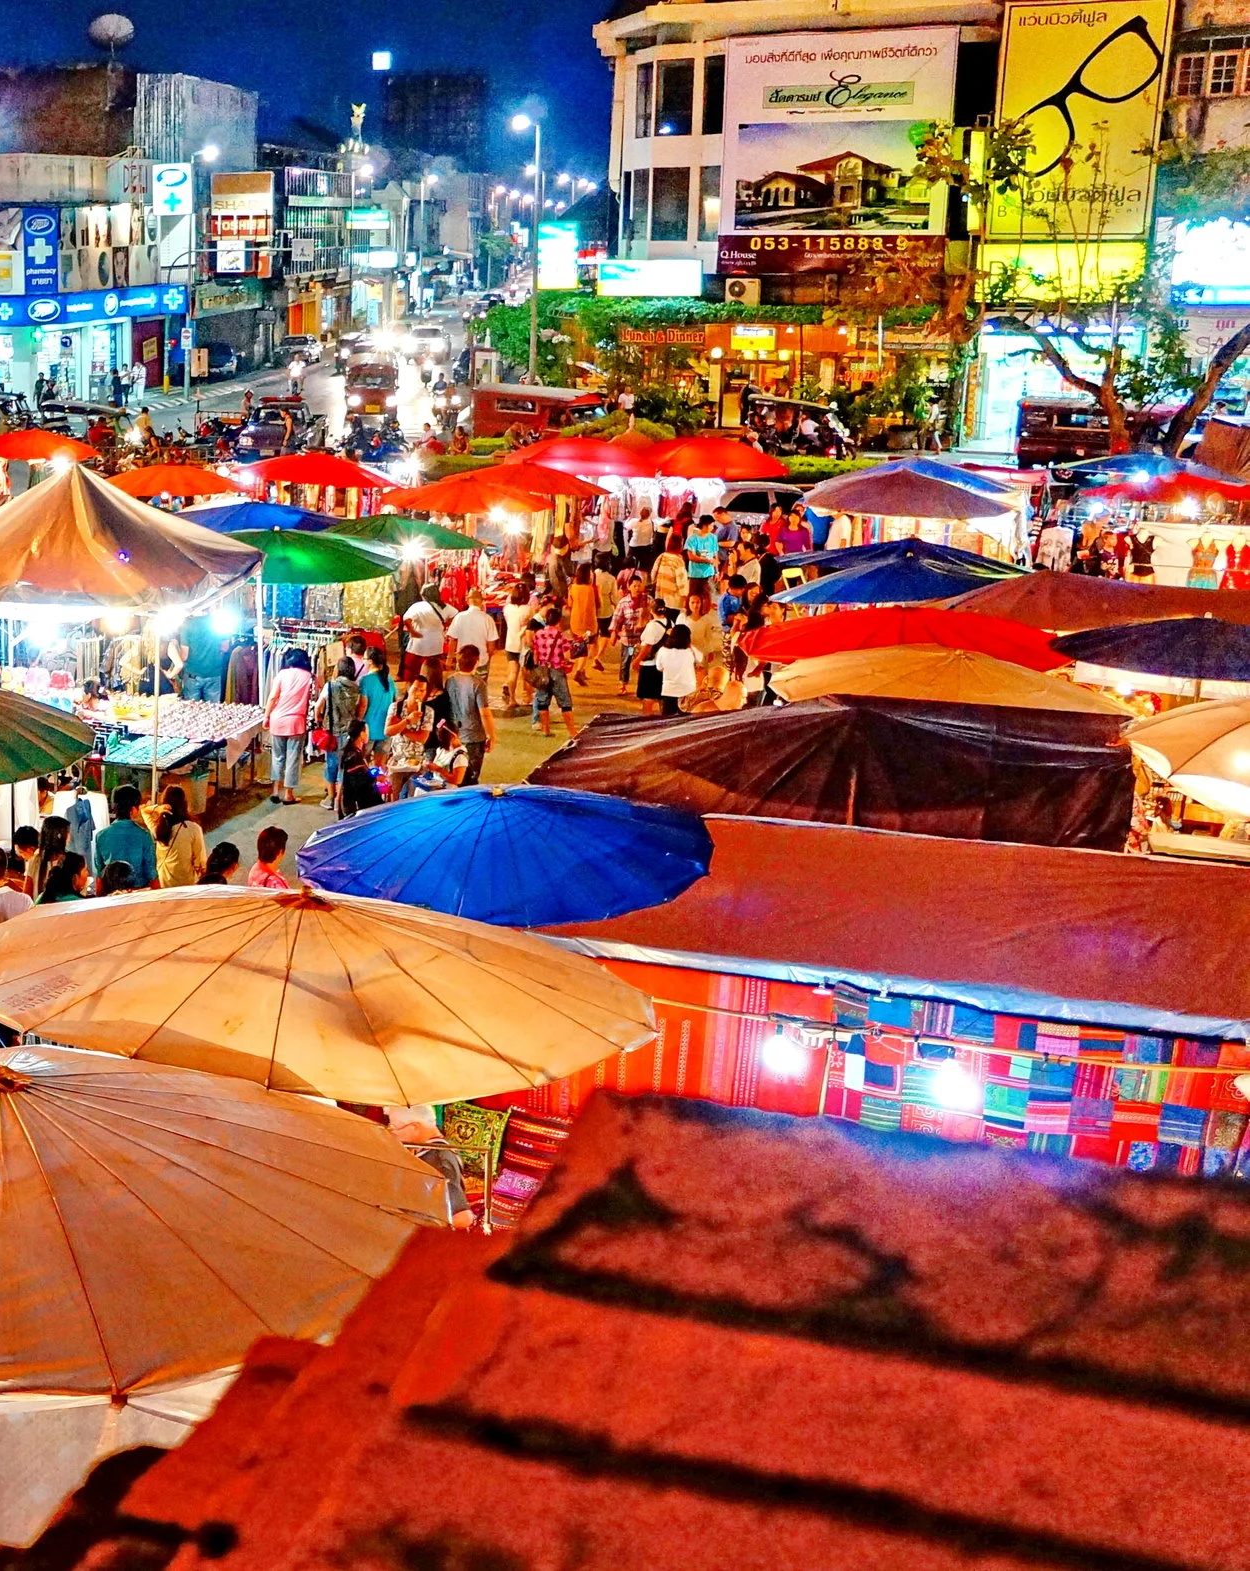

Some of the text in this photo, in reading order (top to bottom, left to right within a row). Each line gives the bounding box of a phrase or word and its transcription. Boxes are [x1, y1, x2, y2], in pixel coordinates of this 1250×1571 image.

[824, 69, 908, 108] Elegance
[26, 267, 57, 276] pharmacy
[667, 328, 705, 343] Dinner
